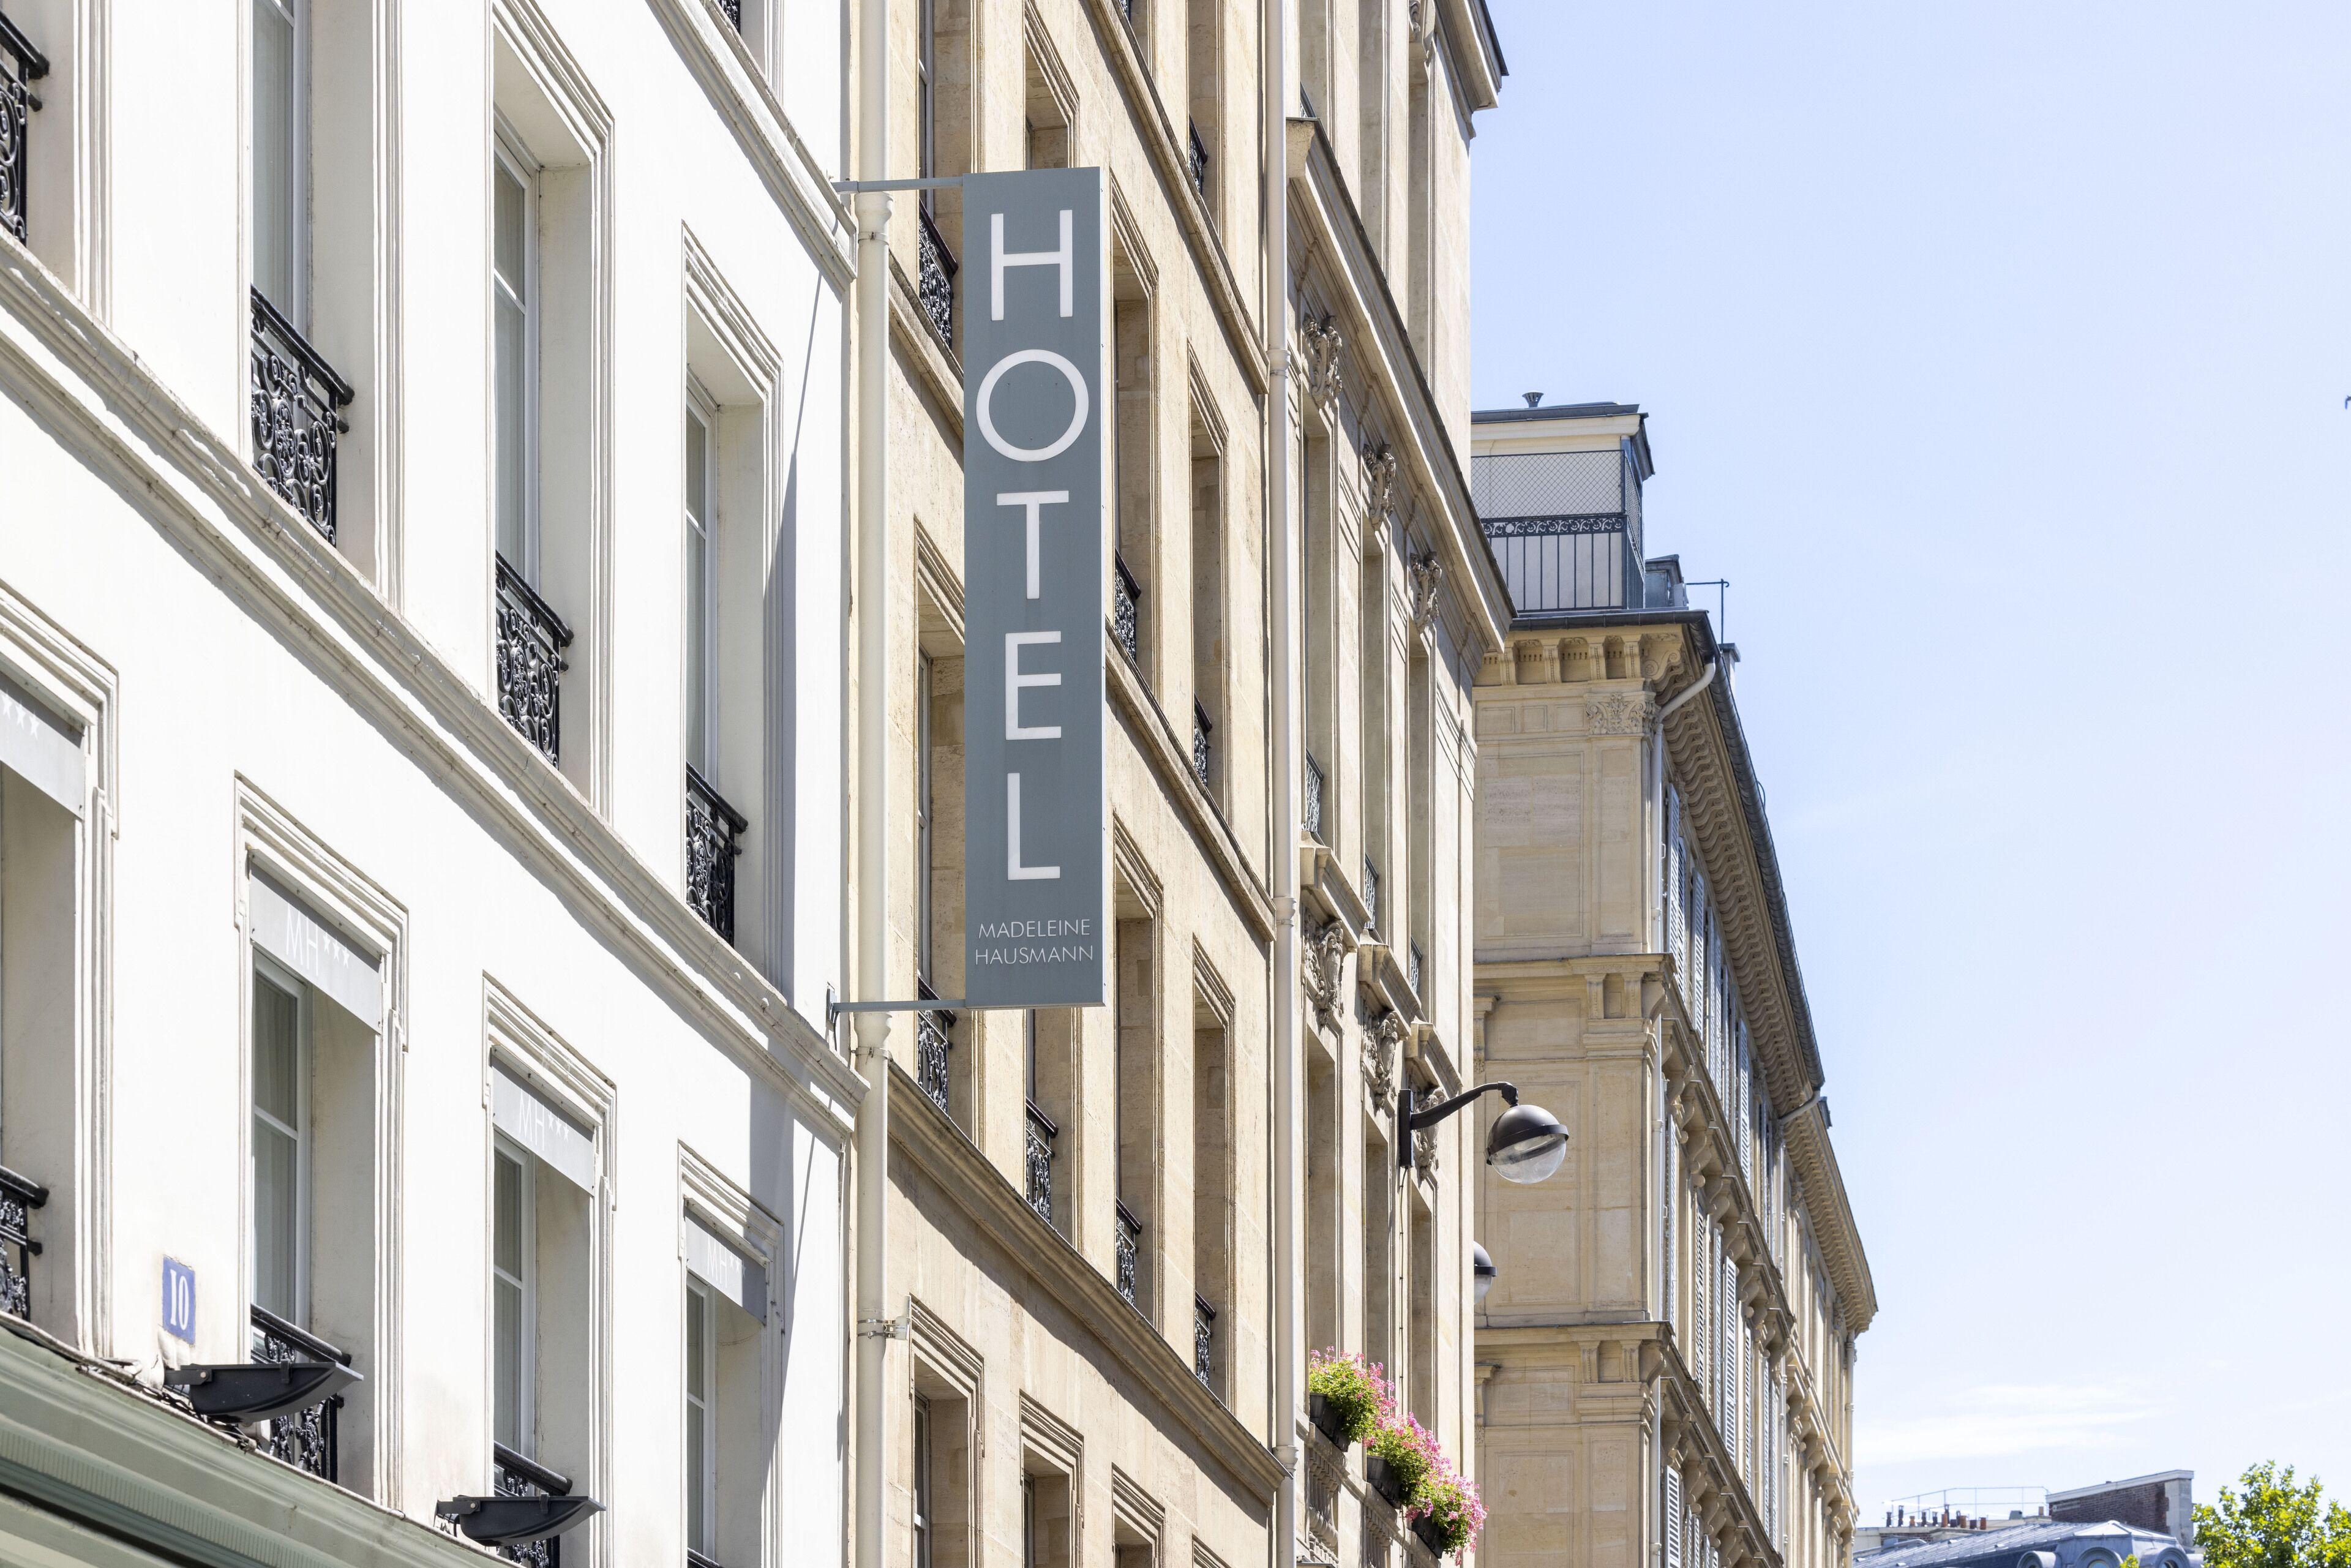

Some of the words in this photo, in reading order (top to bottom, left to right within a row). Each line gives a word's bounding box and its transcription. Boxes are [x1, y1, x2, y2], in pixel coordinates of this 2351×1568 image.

[976, 209, 1089, 880] HOTEL
[978, 918, 1090, 939] MADELEINE
[975, 945, 1093, 965] HAUSMANN
[170, 1269, 189, 1330] 10
